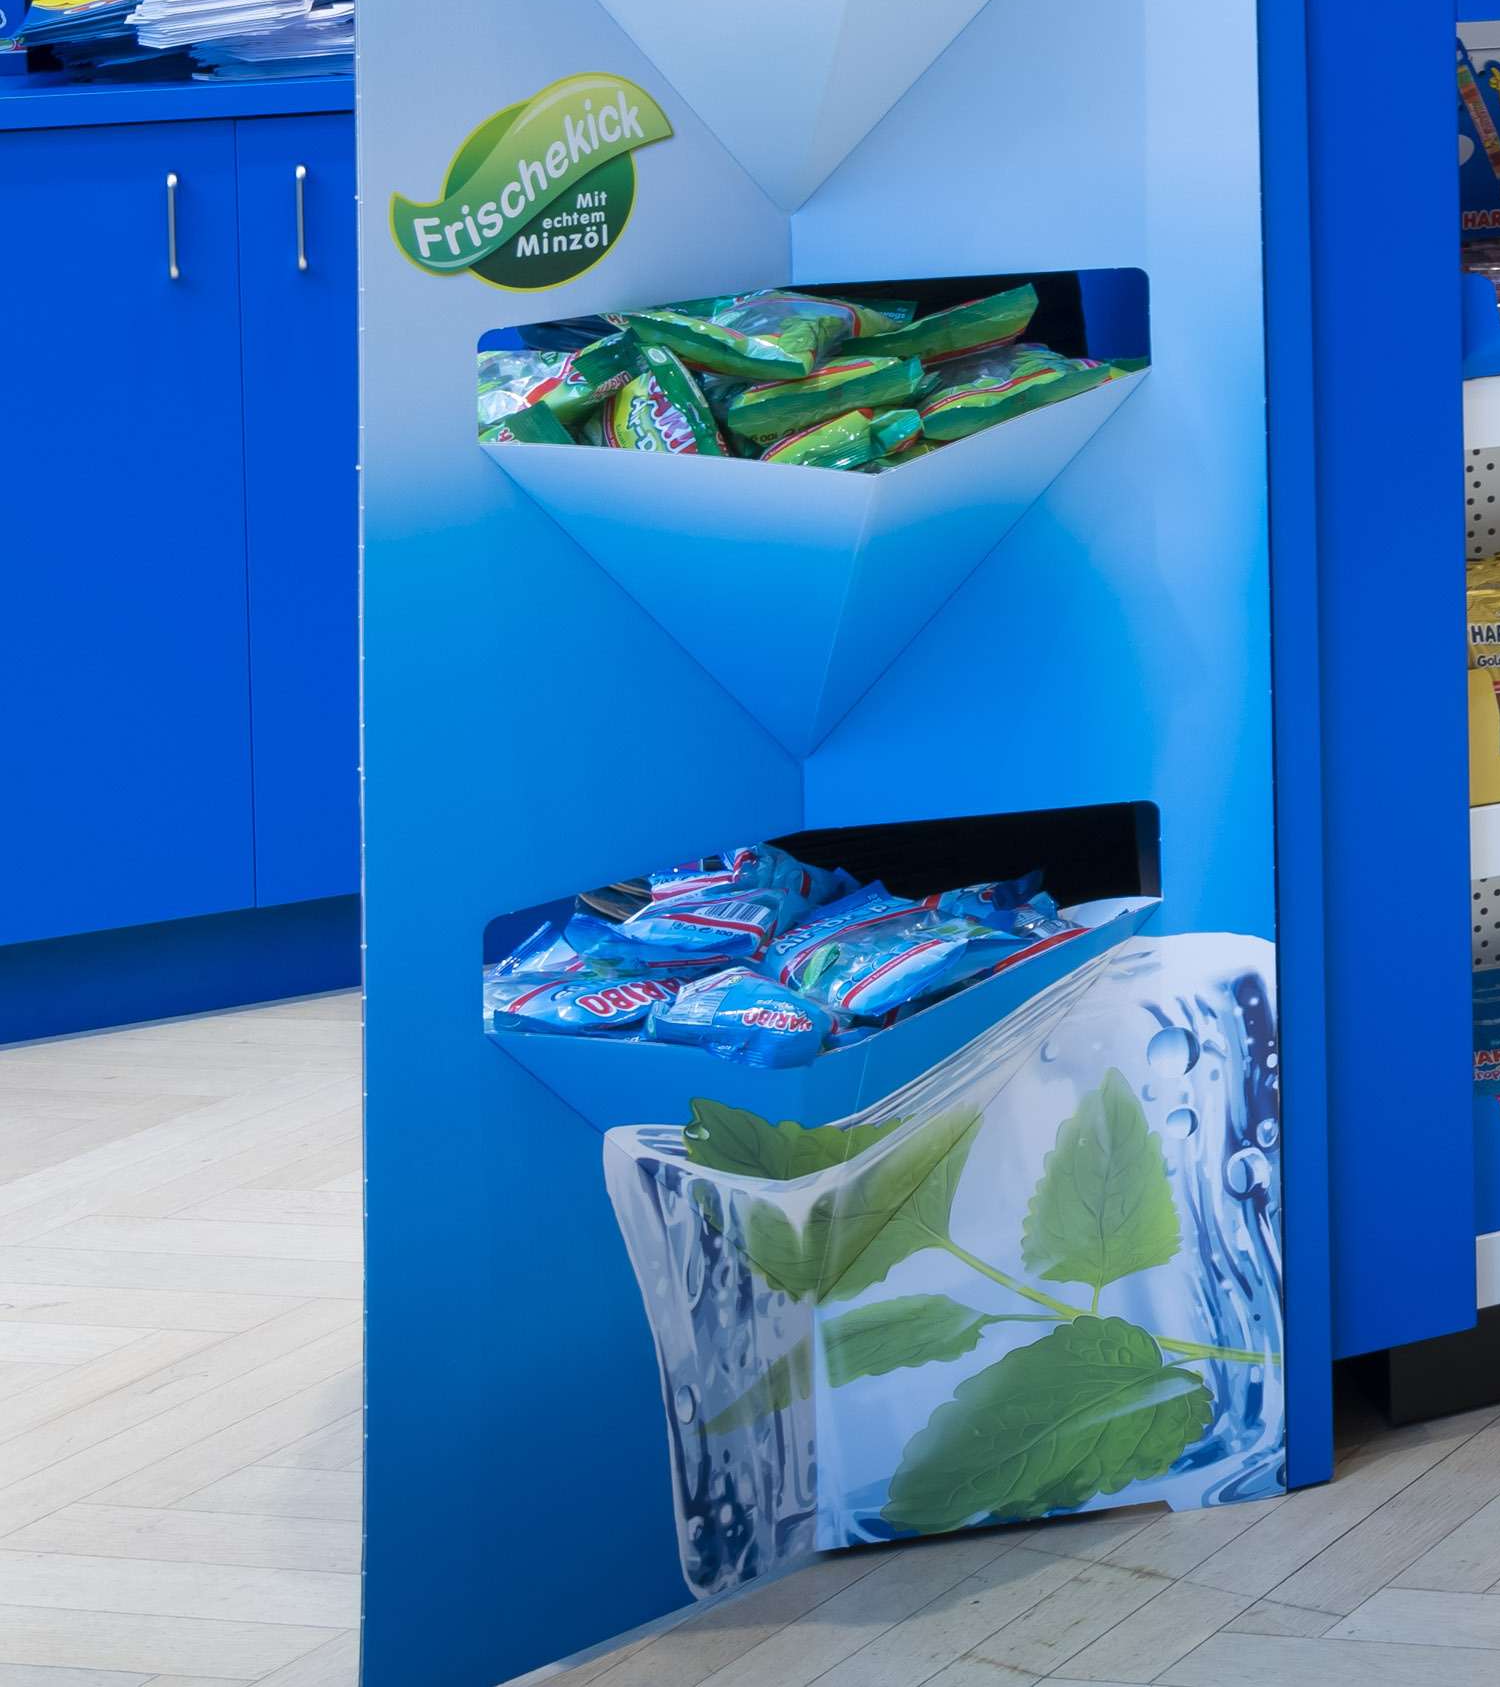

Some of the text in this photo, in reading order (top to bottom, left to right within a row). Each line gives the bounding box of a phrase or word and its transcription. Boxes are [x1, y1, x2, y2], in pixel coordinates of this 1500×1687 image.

[413, 91, 644, 257] Frischekick
[576, 192, 608, 210] Mit
[542, 210, 605, 230] echtem
[516, 226, 608, 258] Minzöl
